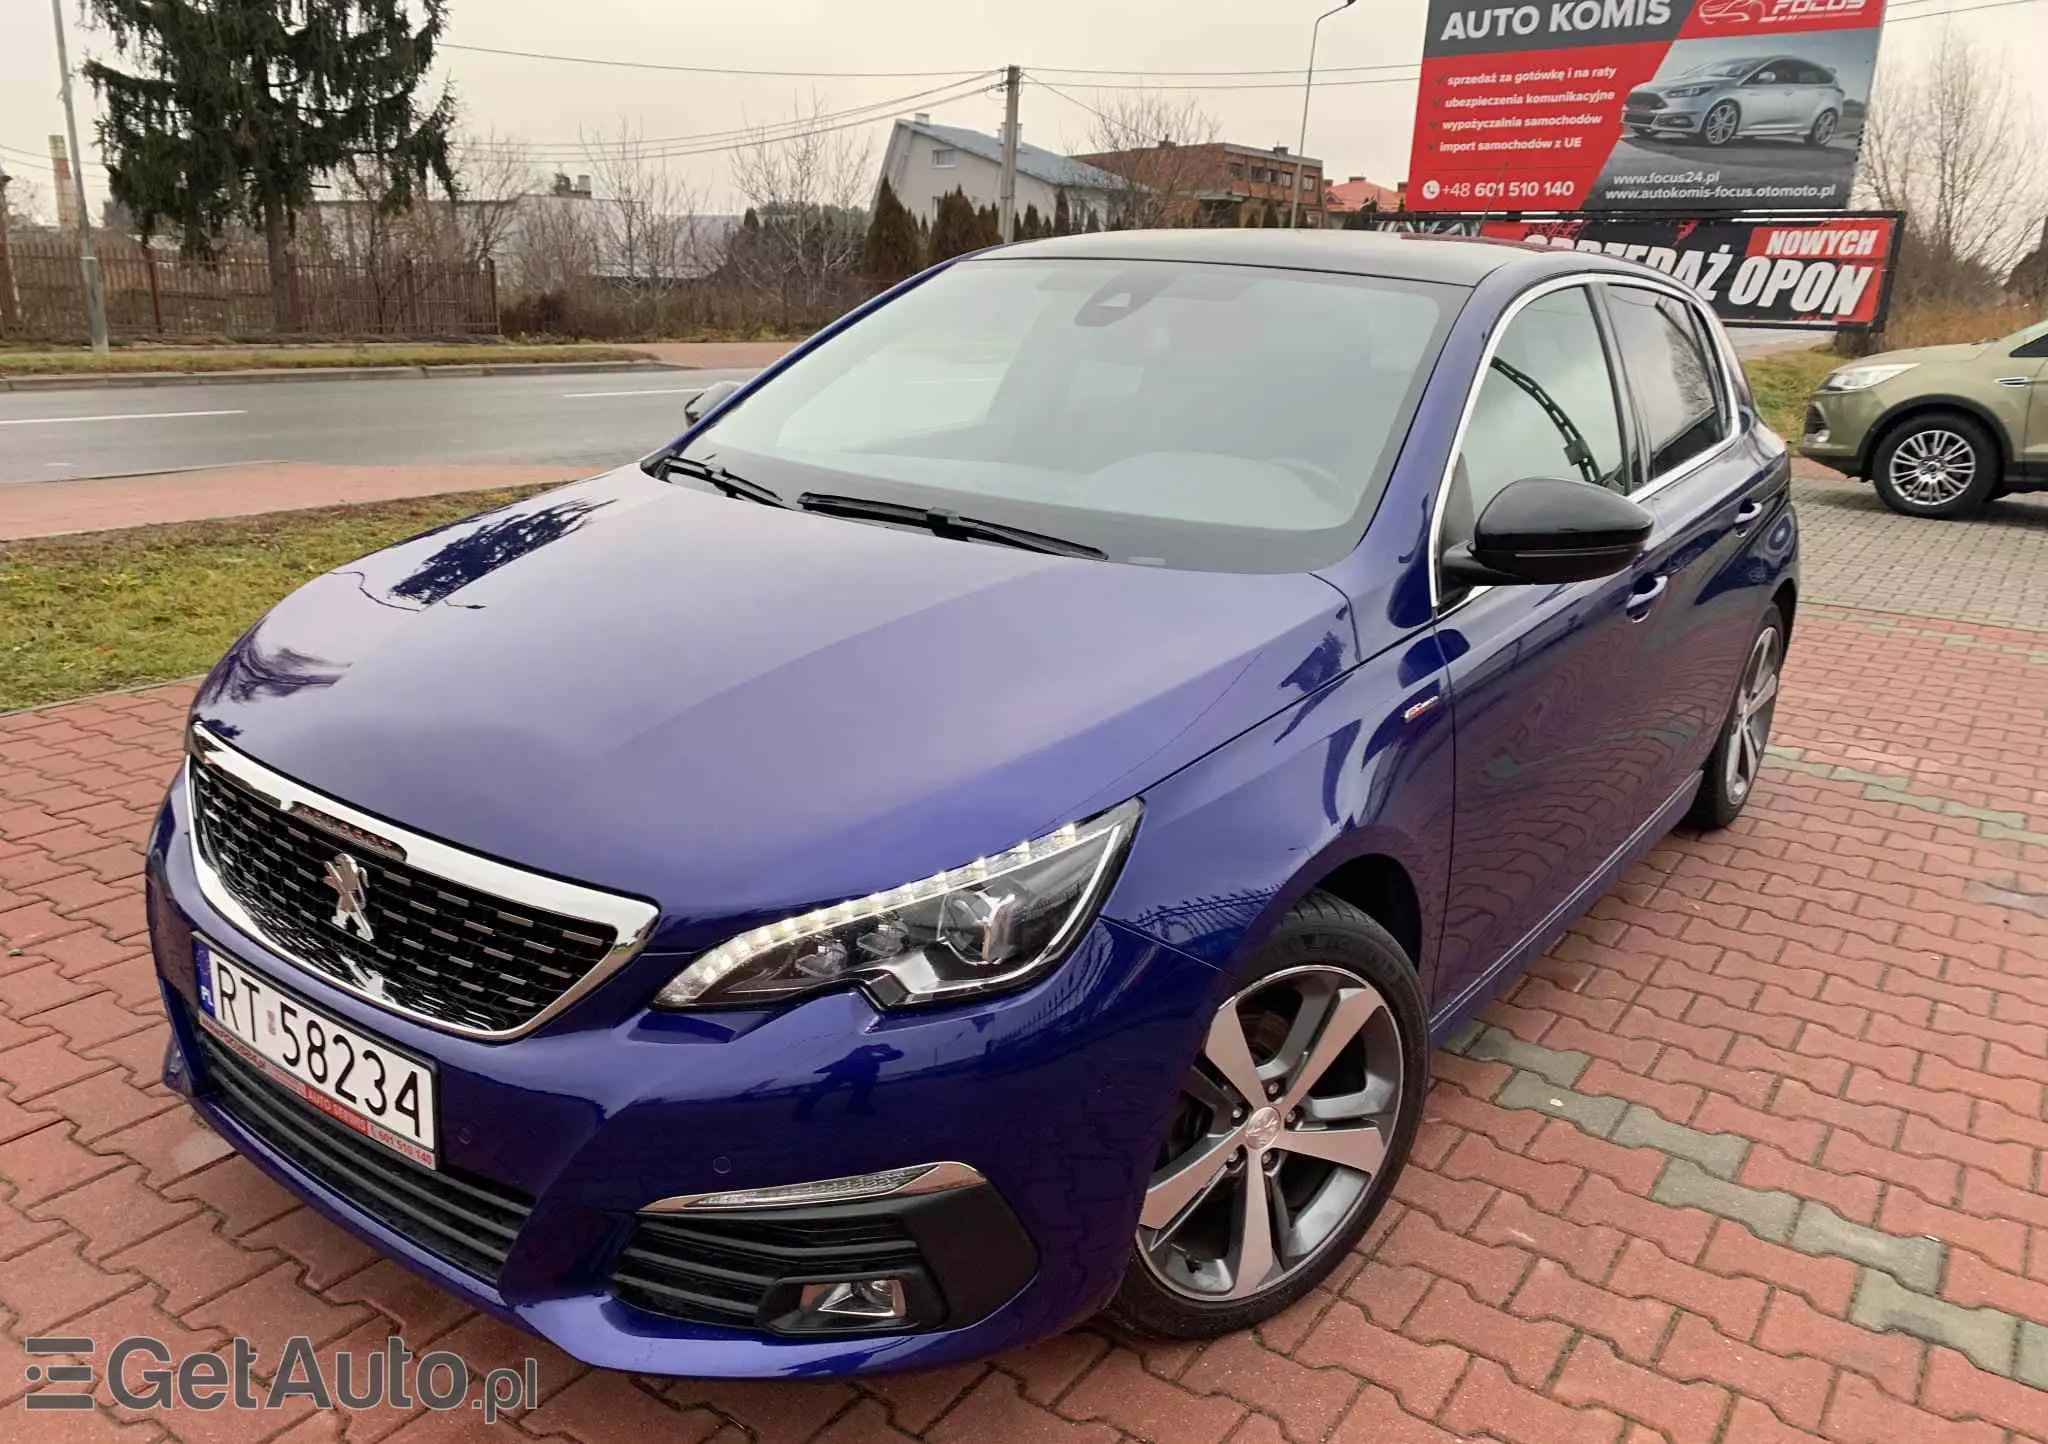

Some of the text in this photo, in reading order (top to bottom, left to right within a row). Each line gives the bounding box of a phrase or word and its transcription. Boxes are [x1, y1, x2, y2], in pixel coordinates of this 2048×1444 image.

[1440, 0, 1672, 41] AUTO KOMIS
[1499, 74, 1513, 83] za
[1515, 70, 1564, 84] gotówkę
[1575, 69, 1590, 78] na
[1593, 66, 1617, 79] raty
[1445, 90, 1616, 110] ubezpieczenia komunikacyjne
[1524, 113, 1602, 127] samochodów
[1440, 141, 1476, 154] import
[1477, 138, 1552, 151] samochodów
[1564, 136, 1583, 148] UE
[1613, 170, 1720, 185] www.focus24.pl
[1442, 179, 1575, 197] +48 601 510 140
[1605, 183, 1837, 200] www.autokomis-focus.otomoto.pl
[1764, 229, 1879, 256] NOWYCH
[1728, 255, 1874, 316] OPON
[216, 962, 260, 1043] RT
[279, 1000, 421, 1138] 58234
